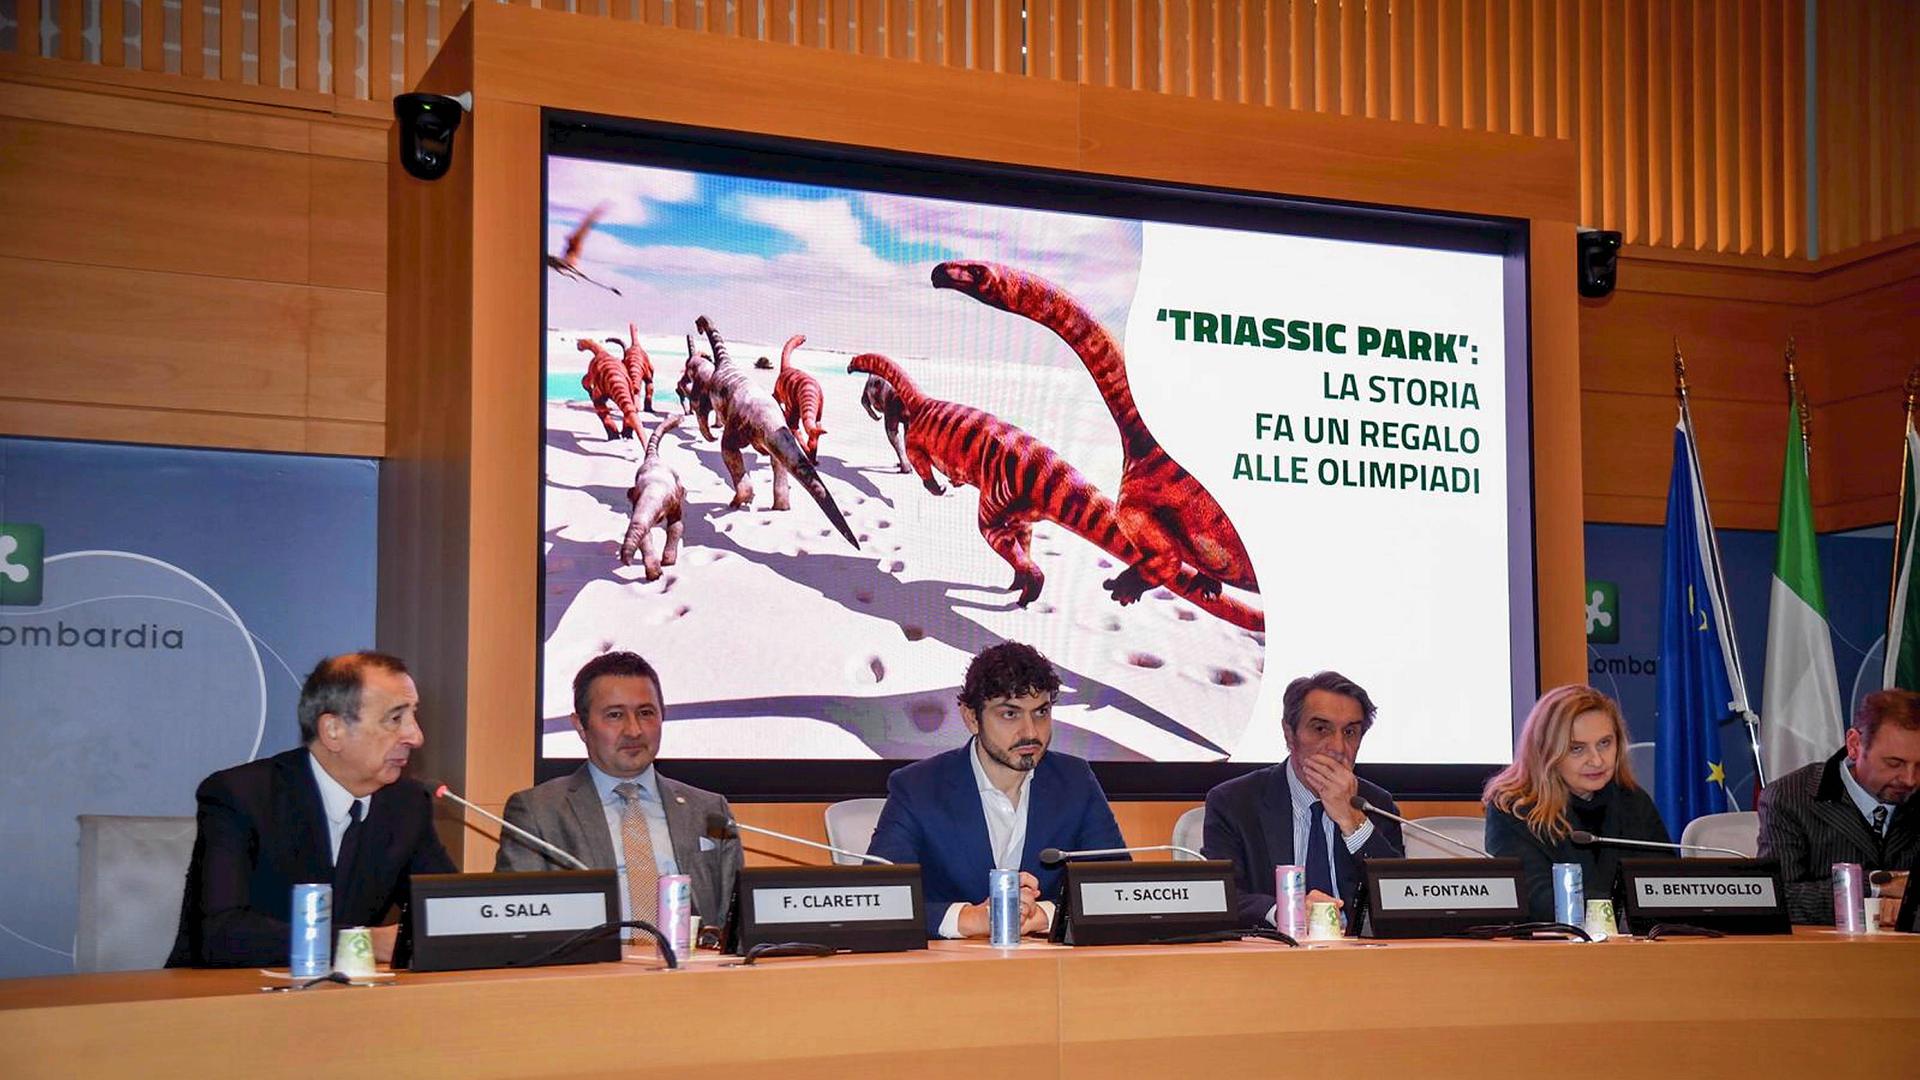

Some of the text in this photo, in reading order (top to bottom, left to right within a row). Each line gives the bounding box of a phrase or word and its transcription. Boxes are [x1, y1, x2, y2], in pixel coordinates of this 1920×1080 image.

[1323, 371, 1480, 410] LA STORIA
[1256, 413, 1480, 454] FA UN REGALO
[1232, 453, 1480, 494] ALLE OLIMPIADI
[1588, 655, 1656, 675] omba
[1115, 888, 1190, 901] T. SACCHI
[1404, 884, 1489, 897] A. FONTANA
[1645, 883, 1762, 895] B. BENTIVOGLIO
[783, 894, 881, 909] F. CLARETTI
[480, 903, 551, 918] G. SALA
